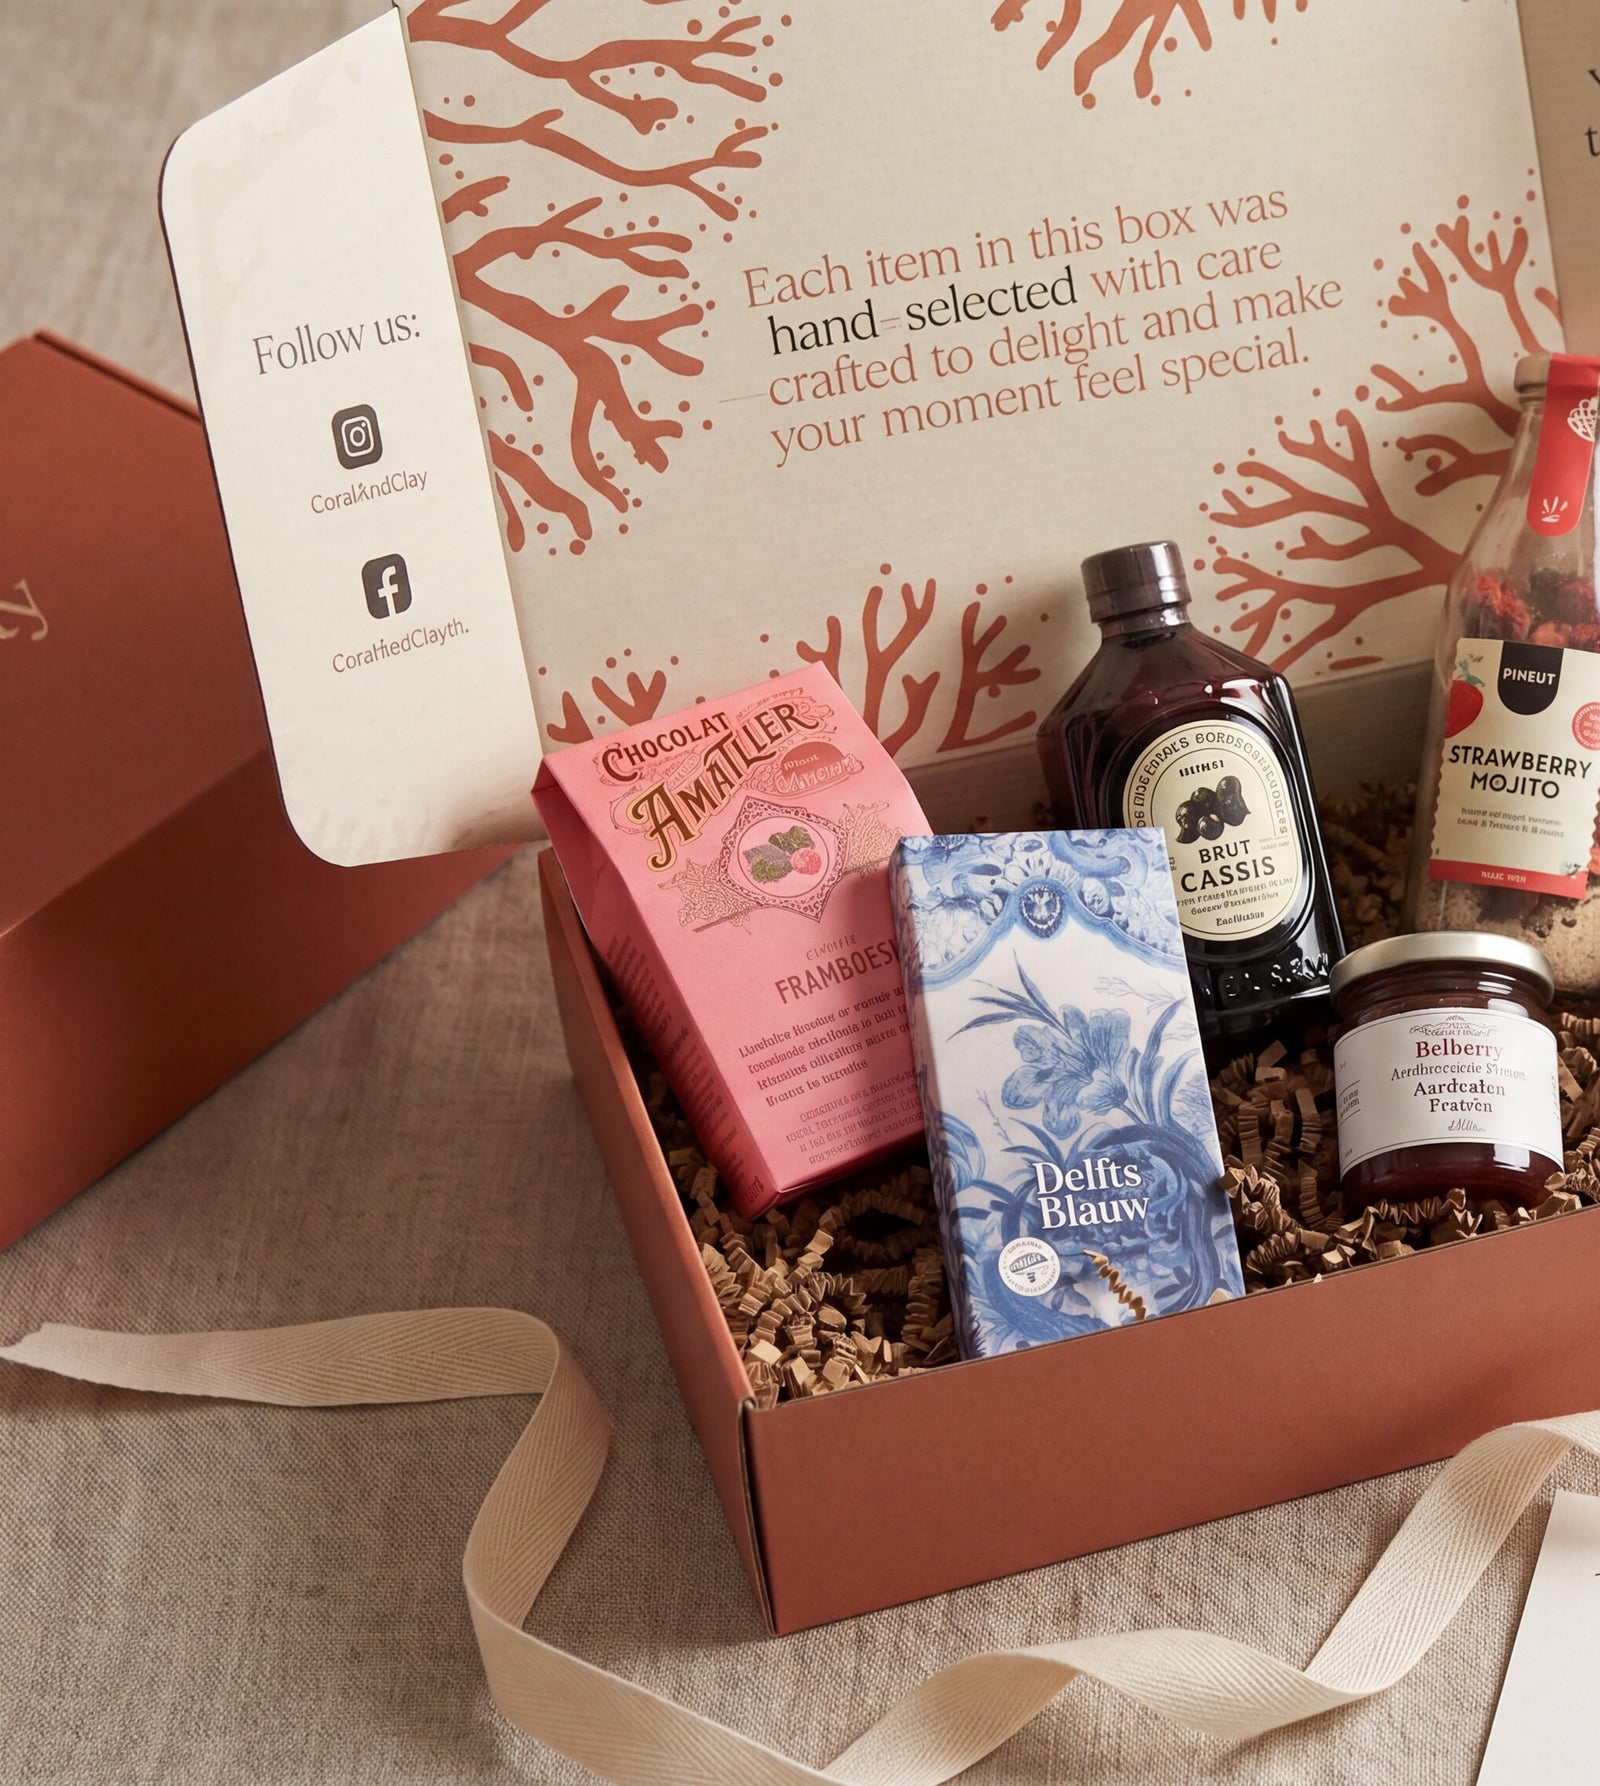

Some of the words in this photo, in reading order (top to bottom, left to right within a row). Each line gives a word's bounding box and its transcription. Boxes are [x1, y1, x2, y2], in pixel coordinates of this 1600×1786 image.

[742, 253, 853, 310] Each
[865, 242, 960, 289] item
[973, 231, 1016, 272] in
[1027, 215, 1104, 262] this
[1113, 205, 1197, 246] box
[1206, 189, 1289, 229] was
[1089, 252, 1182, 300] with
[1196, 241, 1283, 282] care
[252, 323, 365, 376] Follow
[373, 314, 421, 346] us:
[768, 343, 918, 407] crafted
[930, 341, 974, 379] to
[988, 311, 1130, 368] delight
[1142, 291, 1219, 342] and
[1232, 274, 1343, 327] make
[770, 415, 866, 469] your
[882, 373, 1062, 438] moment
[1074, 353, 1148, 403] feel
[1160, 326, 1310, 395] special.
[1502, 667, 1556, 686] PINEUT
[601, 712, 733, 782] CHOCOLAT
[1448, 745, 1592, 779] STRAWBERRY
[627, 702, 820, 872] AMATLLER
[1470, 771, 1560, 799] MOJITO
[1198, 839, 1251, 865] BRUT
[1180, 856, 1276, 893] CASSIS
[1415, 1038, 1504, 1062] Belberry
[1032, 1157, 1142, 1196] Delfts
[1037, 1194, 1150, 1230] Blauw
